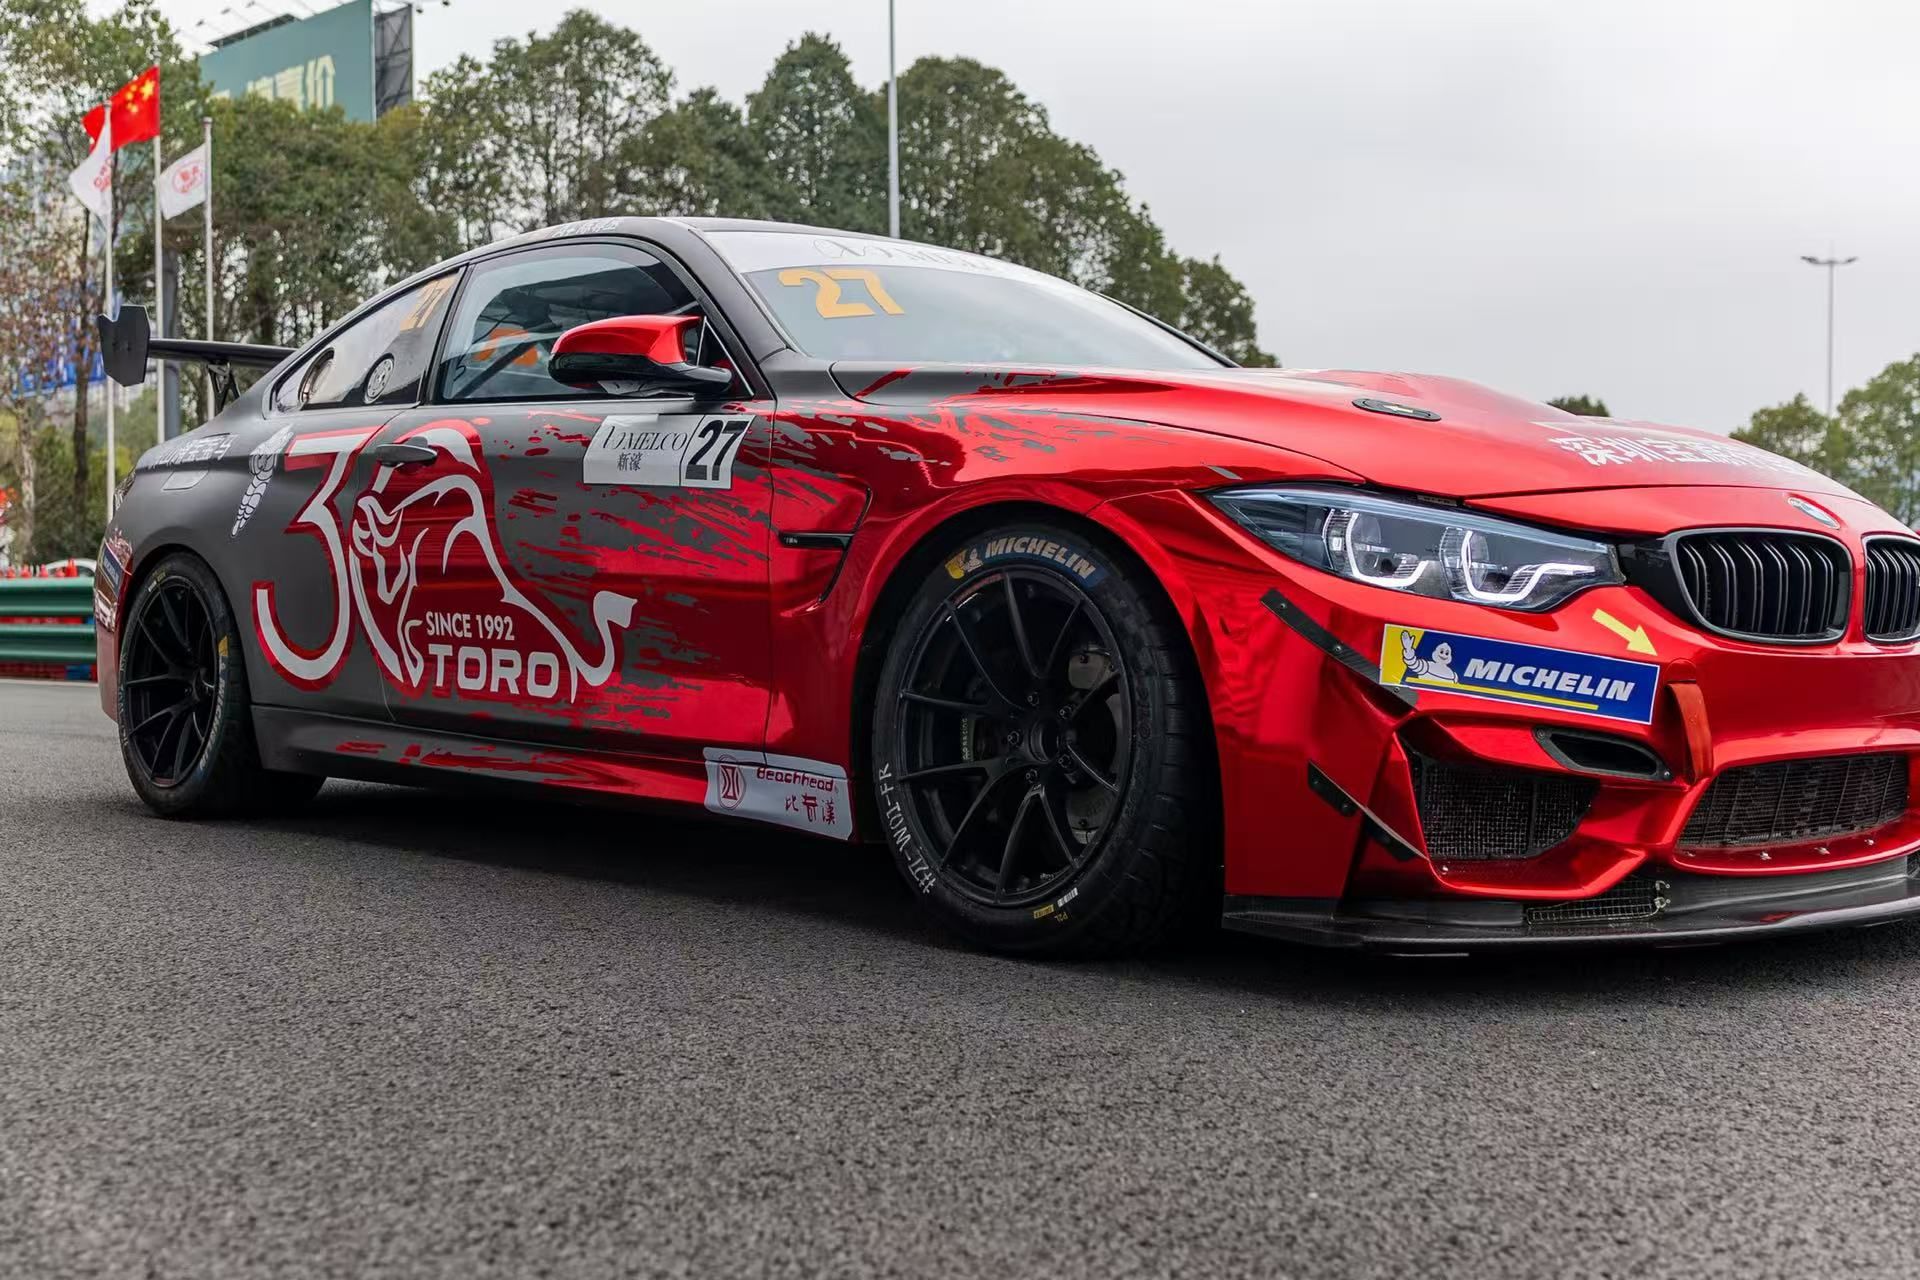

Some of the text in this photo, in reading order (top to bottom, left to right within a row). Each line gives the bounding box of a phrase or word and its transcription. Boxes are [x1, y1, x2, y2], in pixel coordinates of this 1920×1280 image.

[778, 268, 906, 319] 27
[685, 419, 750, 481] 27
[984, 536, 1096, 580] MICHELIN
[425, 611, 515, 641] SINCE 1992
[428, 643, 560, 699] TORO
[1463, 658, 1636, 702] MICHELIN
[756, 767, 834, 792] Beachhead
